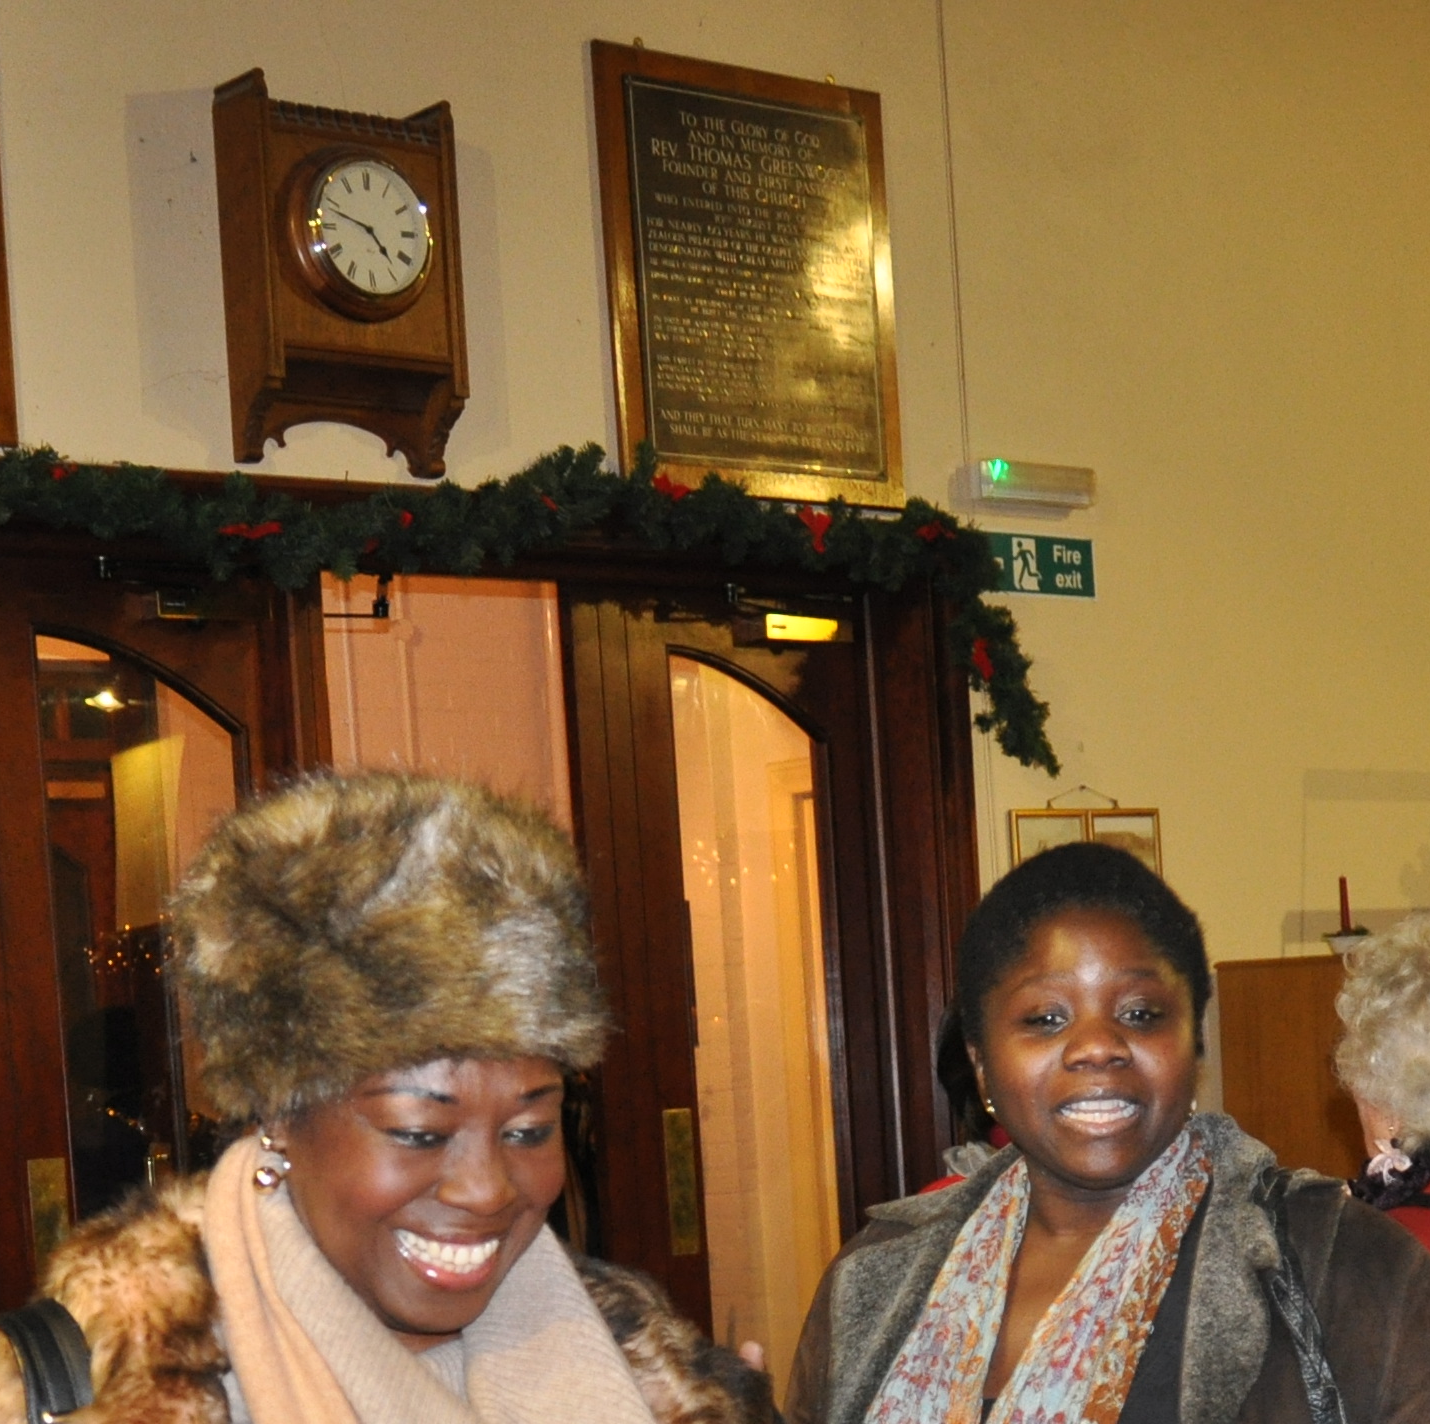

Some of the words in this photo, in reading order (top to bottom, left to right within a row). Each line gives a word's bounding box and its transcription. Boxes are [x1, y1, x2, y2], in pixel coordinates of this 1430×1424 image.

[679, 109, 697, 127] TO
[702, 113, 725, 132] THE
[687, 128, 715, 145] AND
[720, 134, 734, 149] IN
[686, 142, 751, 171] THOMAS
[723, 168, 751, 185] AND
[701, 179, 717, 195] OF
[724, 182, 749, 200] THIS
[1052, 544, 1082, 565] Fire
[1055, 571, 1082, 589] exit
